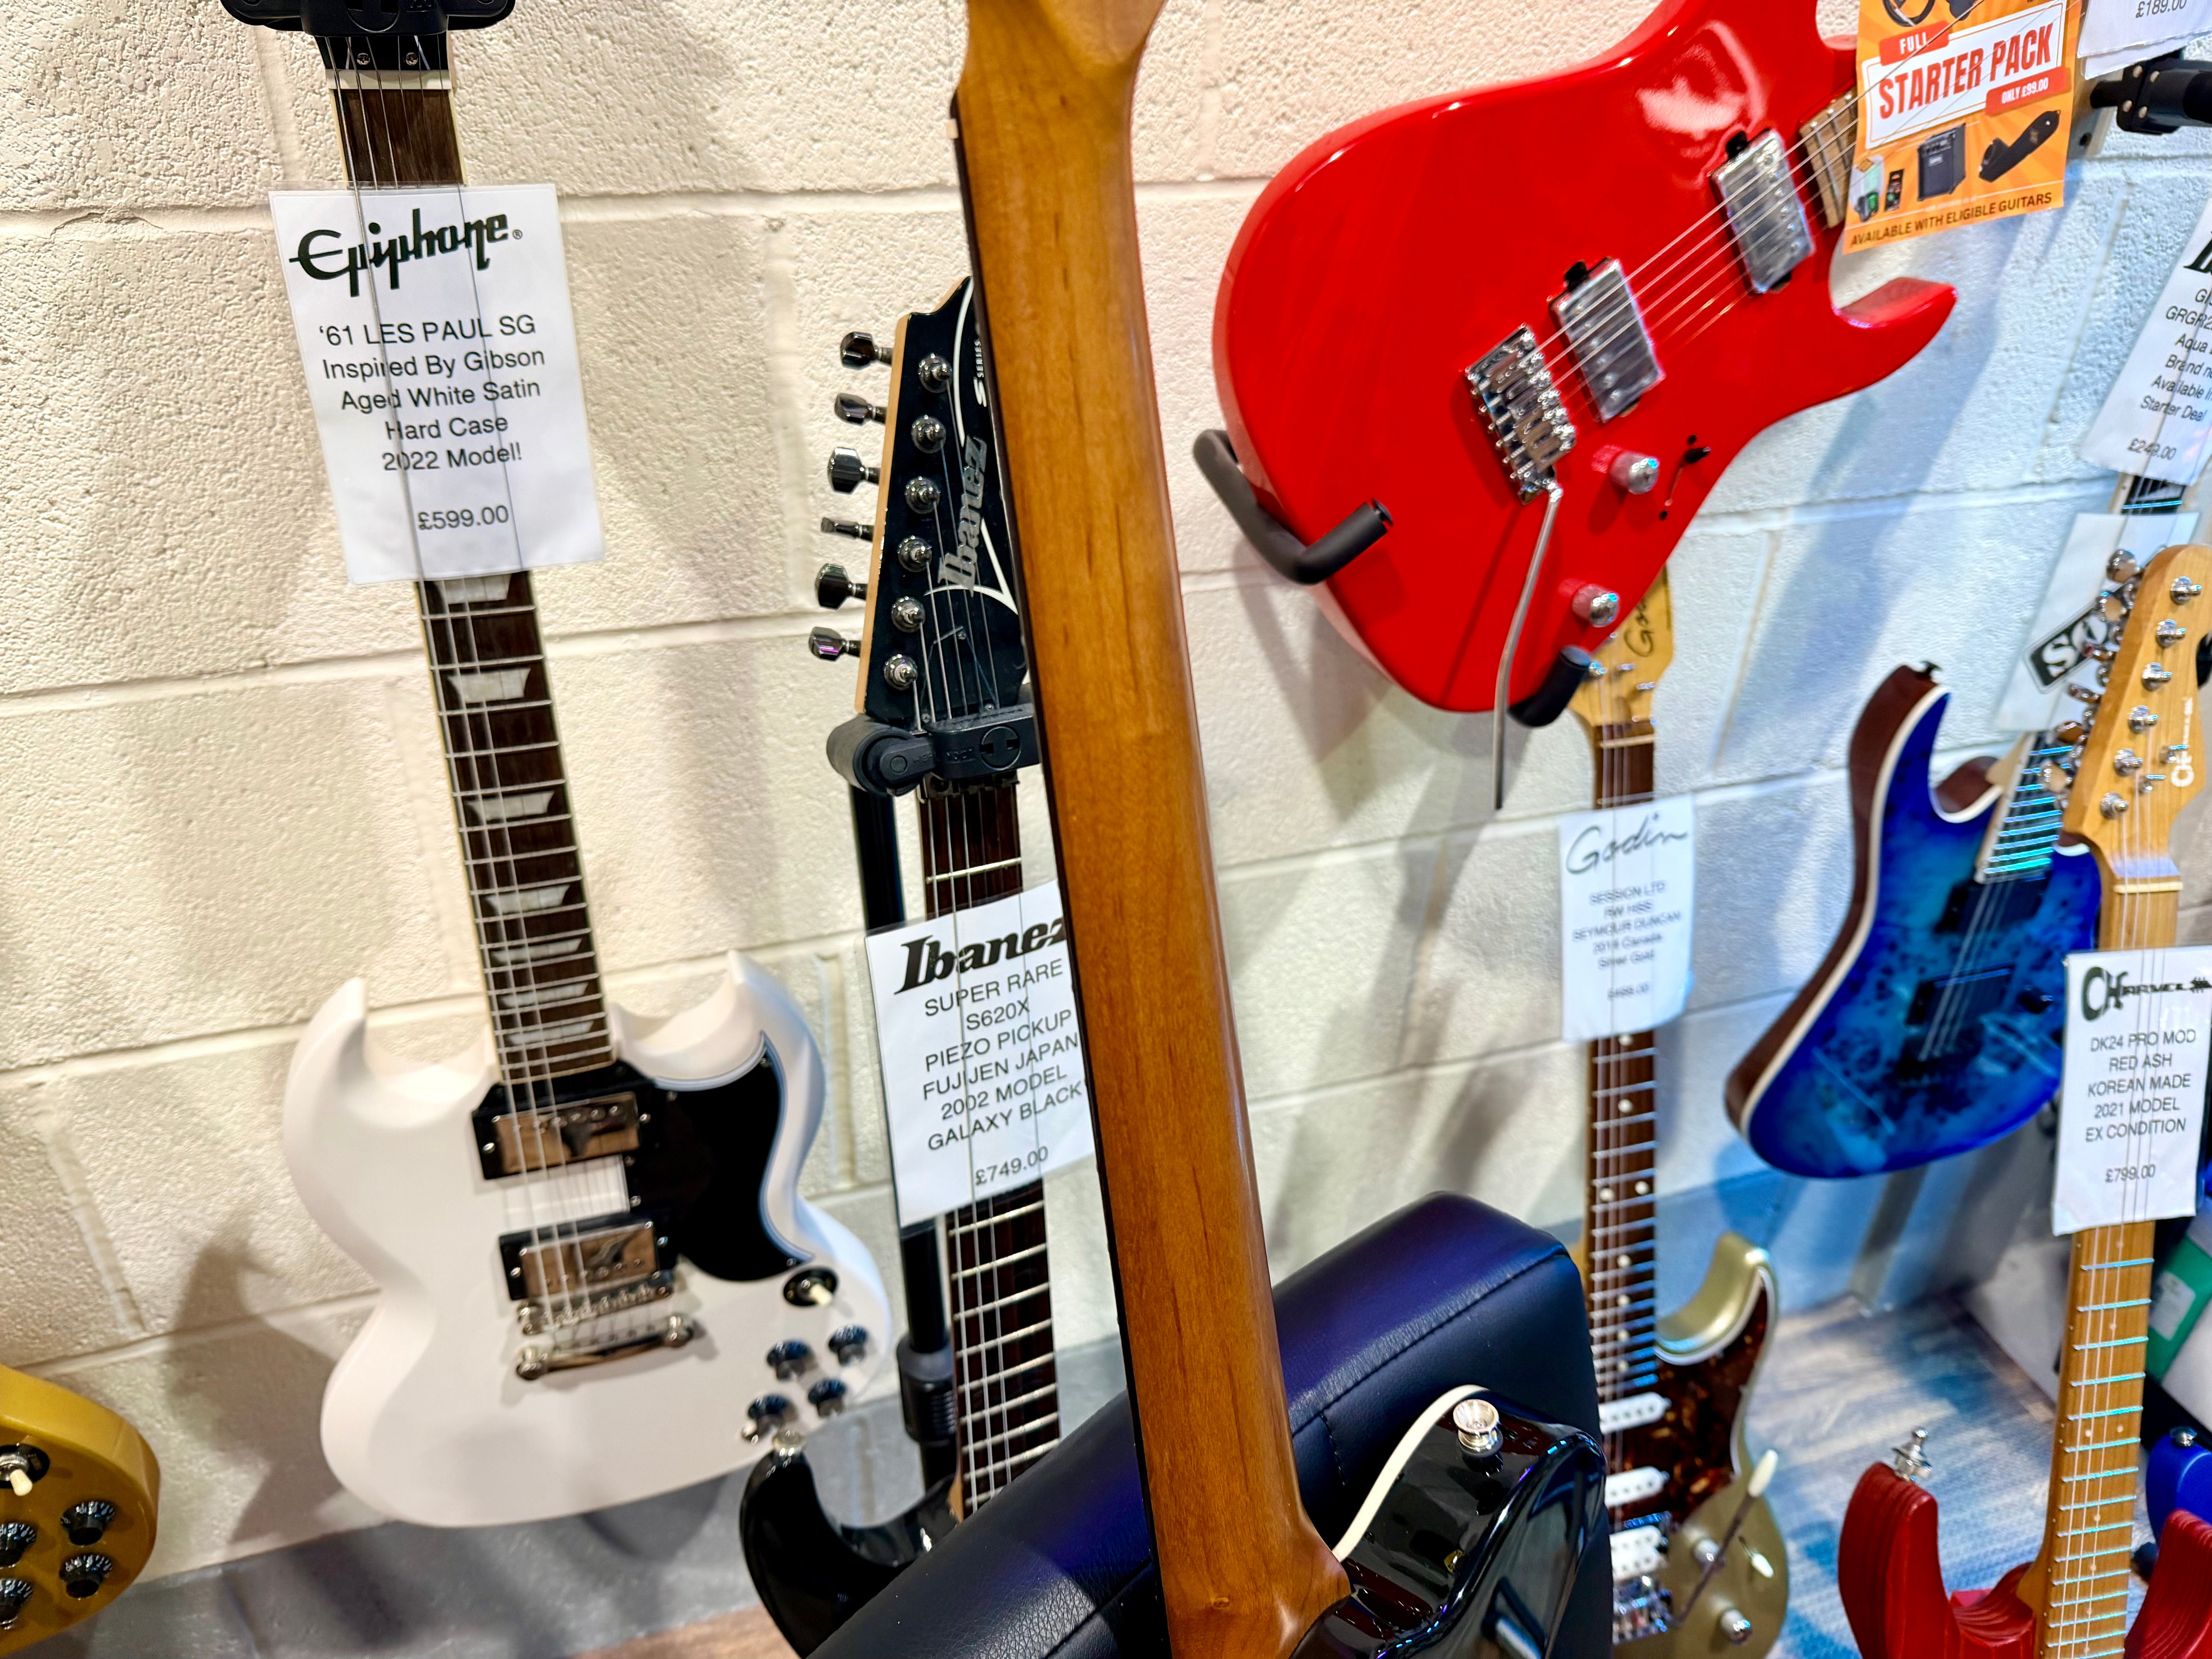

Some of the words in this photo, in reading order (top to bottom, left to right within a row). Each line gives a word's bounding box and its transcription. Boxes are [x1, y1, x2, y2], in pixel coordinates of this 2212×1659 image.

[2135, 0, 2187, 18] £189.00
[1899, 32, 1927, 55] FULL
[1879, 48, 1984, 120] STARTER
[1990, 22, 2053, 82] PACK
[2002, 88, 2021, 104] ONLY
[2021, 77, 2049, 97] £99.00
[1850, 222, 1912, 248] AVAILABLE
[1915, 215, 1944, 232] WITH
[1946, 203, 1996, 225] ELIGIBLE
[1999, 192, 2052, 212] GUITARS
[289, 208, 508, 297] Epiphone
[363, 323, 415, 345] LES
[423, 318, 492, 343] PAUL
[499, 314, 536, 336] SG
[2166, 306, 2212, 330] GRGR2
[2175, 333, 2208, 353] Aqua
[323, 354, 417, 381] Inspired
[426, 355, 456, 380] By
[464, 349, 546, 371] Gibson
[2165, 354, 2205, 375] Brand
[342, 389, 402, 414] Aged
[408, 383, 476, 408] White
[484, 378, 541, 402] Satin
[2151, 375, 2205, 399] Available
[2140, 395, 2181, 416] Starter
[2181, 405, 2208, 422] Deal
[385, 418, 441, 441] Hard
[449, 416, 509, 436] Case
[382, 450, 439, 471] 2022
[447, 443, 523, 466] Model!
[417, 505, 509, 531] £599.00
[937, 435, 987, 598] Ibanez
[1566, 812, 1687, 874] Godin
[1572, 920, 1631, 941] SEYMOUR
[1634, 910, 1681, 930] DUNCAN
[925, 981, 1001, 1017] SUPER
[1008, 958, 1063, 993] RARE
[966, 996, 1030, 1030] S620X
[926, 1038, 991, 1072] PIEZO
[997, 1009, 1072, 1049] PICKUP
[1015, 1032, 1079, 1070] JAPAN
[2090, 1034, 2123, 1052] DK24
[2128, 1031, 2159, 1047] PRO
[2163, 1029, 2196, 1045] MOD
[2109, 1055, 2138, 1072] RED
[2142, 1053, 2172, 1068] ASH
[941, 1091, 989, 1121] 2002
[996, 1064, 1068, 1103] MODEL
[2088, 1078, 2145, 1097] KOREAN
[2150, 1072, 2191, 1090] MADE
[928, 1108, 1013, 1150] GALAXY
[1019, 1080, 1082, 1120] BLACK
[2094, 1102, 2123, 1119] 2021
[2129, 1097, 2180, 1114] MODEL
[2085, 1126, 2103, 1142] EX
[2106, 1118, 2186, 1139] CONDITION
[975, 1146, 1049, 1186] £749.00
[2105, 1163, 2156, 1183] £799.00
